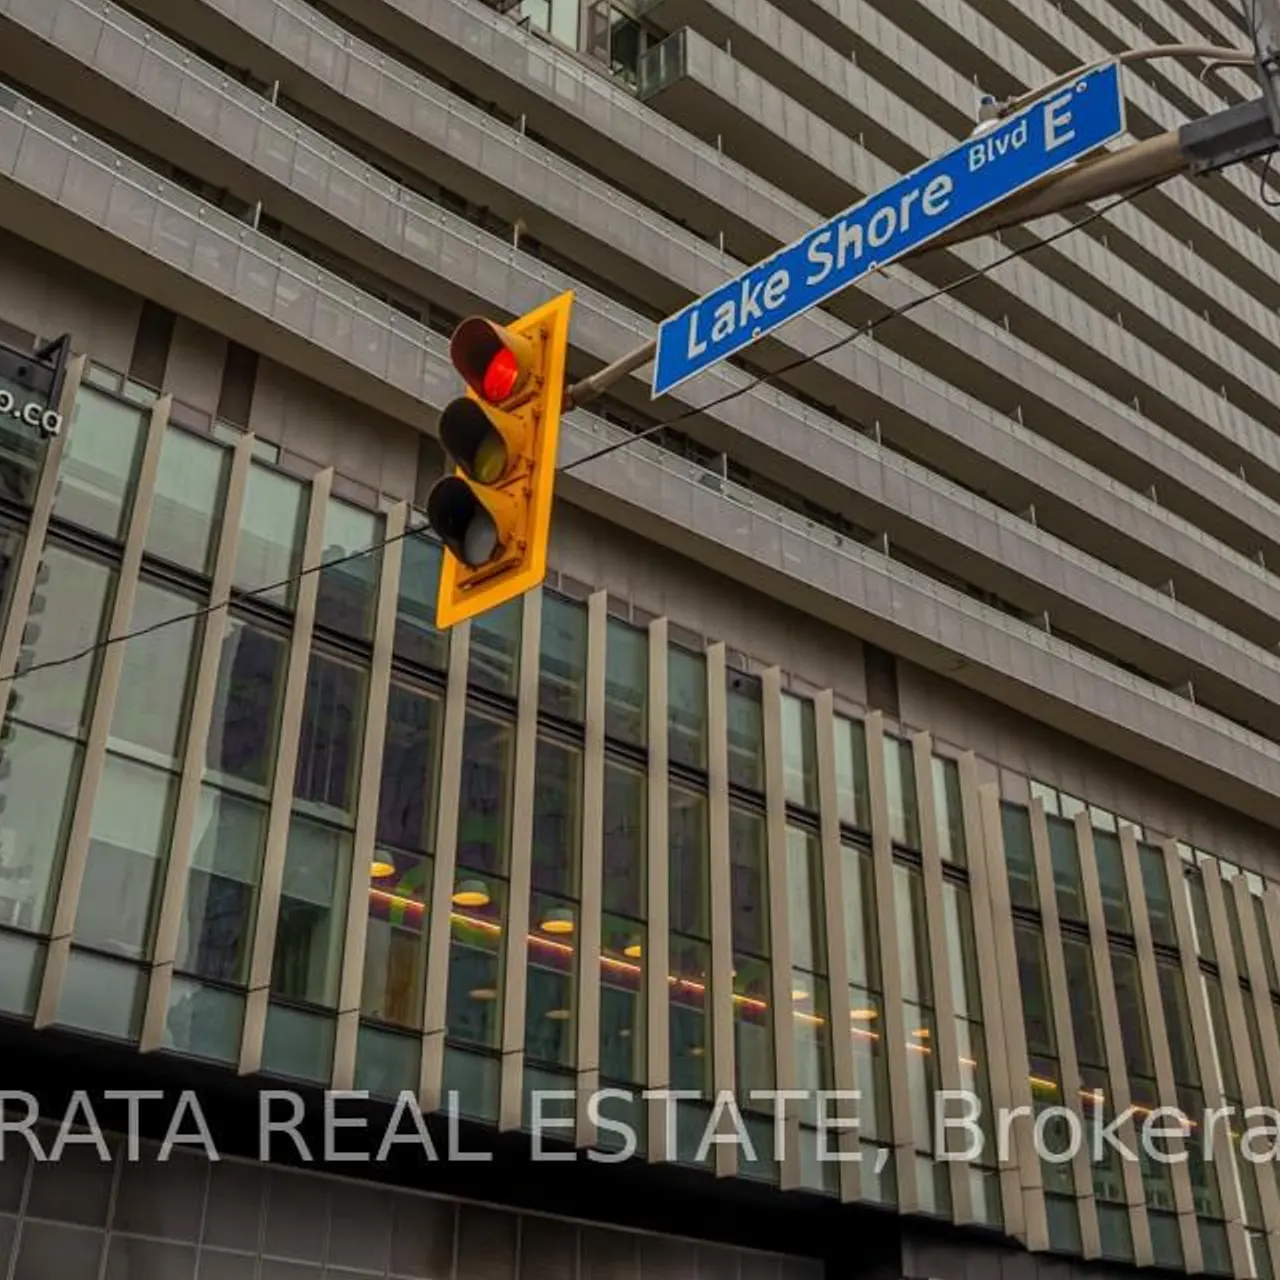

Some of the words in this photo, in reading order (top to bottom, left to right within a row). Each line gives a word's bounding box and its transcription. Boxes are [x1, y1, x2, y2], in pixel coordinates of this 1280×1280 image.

[687, 268, 789, 360] Lake
[806, 175, 954, 286] Shore
[968, 121, 1028, 172] Blvd
[1044, 92, 1076, 152] E
